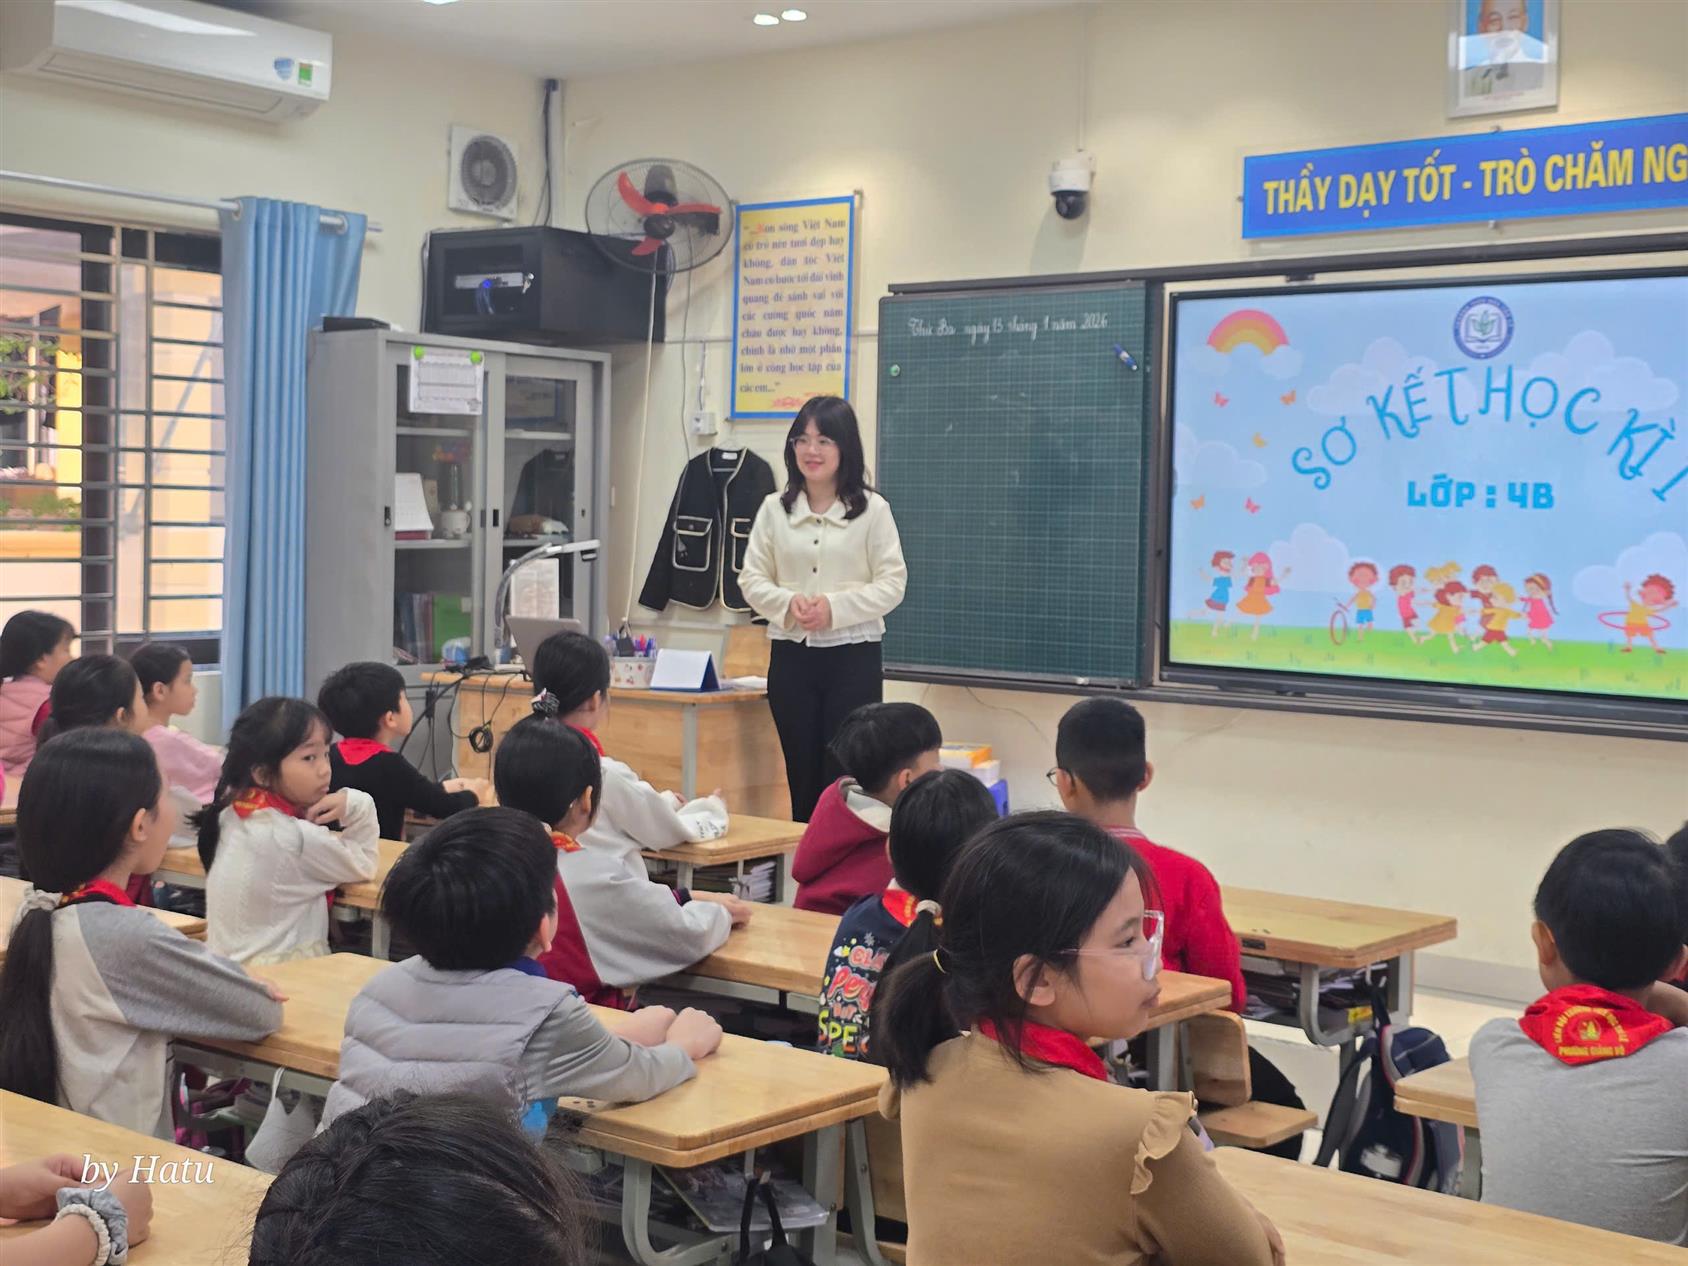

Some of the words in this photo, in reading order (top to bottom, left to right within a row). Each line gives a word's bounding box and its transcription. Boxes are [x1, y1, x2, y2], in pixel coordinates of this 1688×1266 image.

[1264, 163, 1332, 215] THẦY
[1338, 171, 1396, 218] DẠY
[1403, 149, 1456, 203] TỐT
[1462, 180, 1473, 189] -
[1479, 148, 1536, 197] TRÒ
[1544, 141, 1634, 193] CHĂM
[802, 219, 820, 230] Việt
[825, 218, 846, 228] Nam
[829, 236, 844, 247] hay
[826, 253, 844, 264] Việt
[743, 276, 764, 286] Nam
[742, 295, 769, 304] quang
[1052, 318, 1076, 330] năm
[1080, 312, 1109, 329] 2026
[792, 327, 807, 337] hay
[768, 344, 776, 354] là
[800, 344, 816, 354] một
[740, 383, 753, 392] các
[1291, 416, 1357, 491] SƠ
[1366, 366, 1470, 440] KẾT
[1478, 365, 1601, 436] HỌC
[1606, 407, 1676, 481] KÌ
[1407, 473, 1475, 508] LỚP
[1507, 482, 1555, 509] 4B
